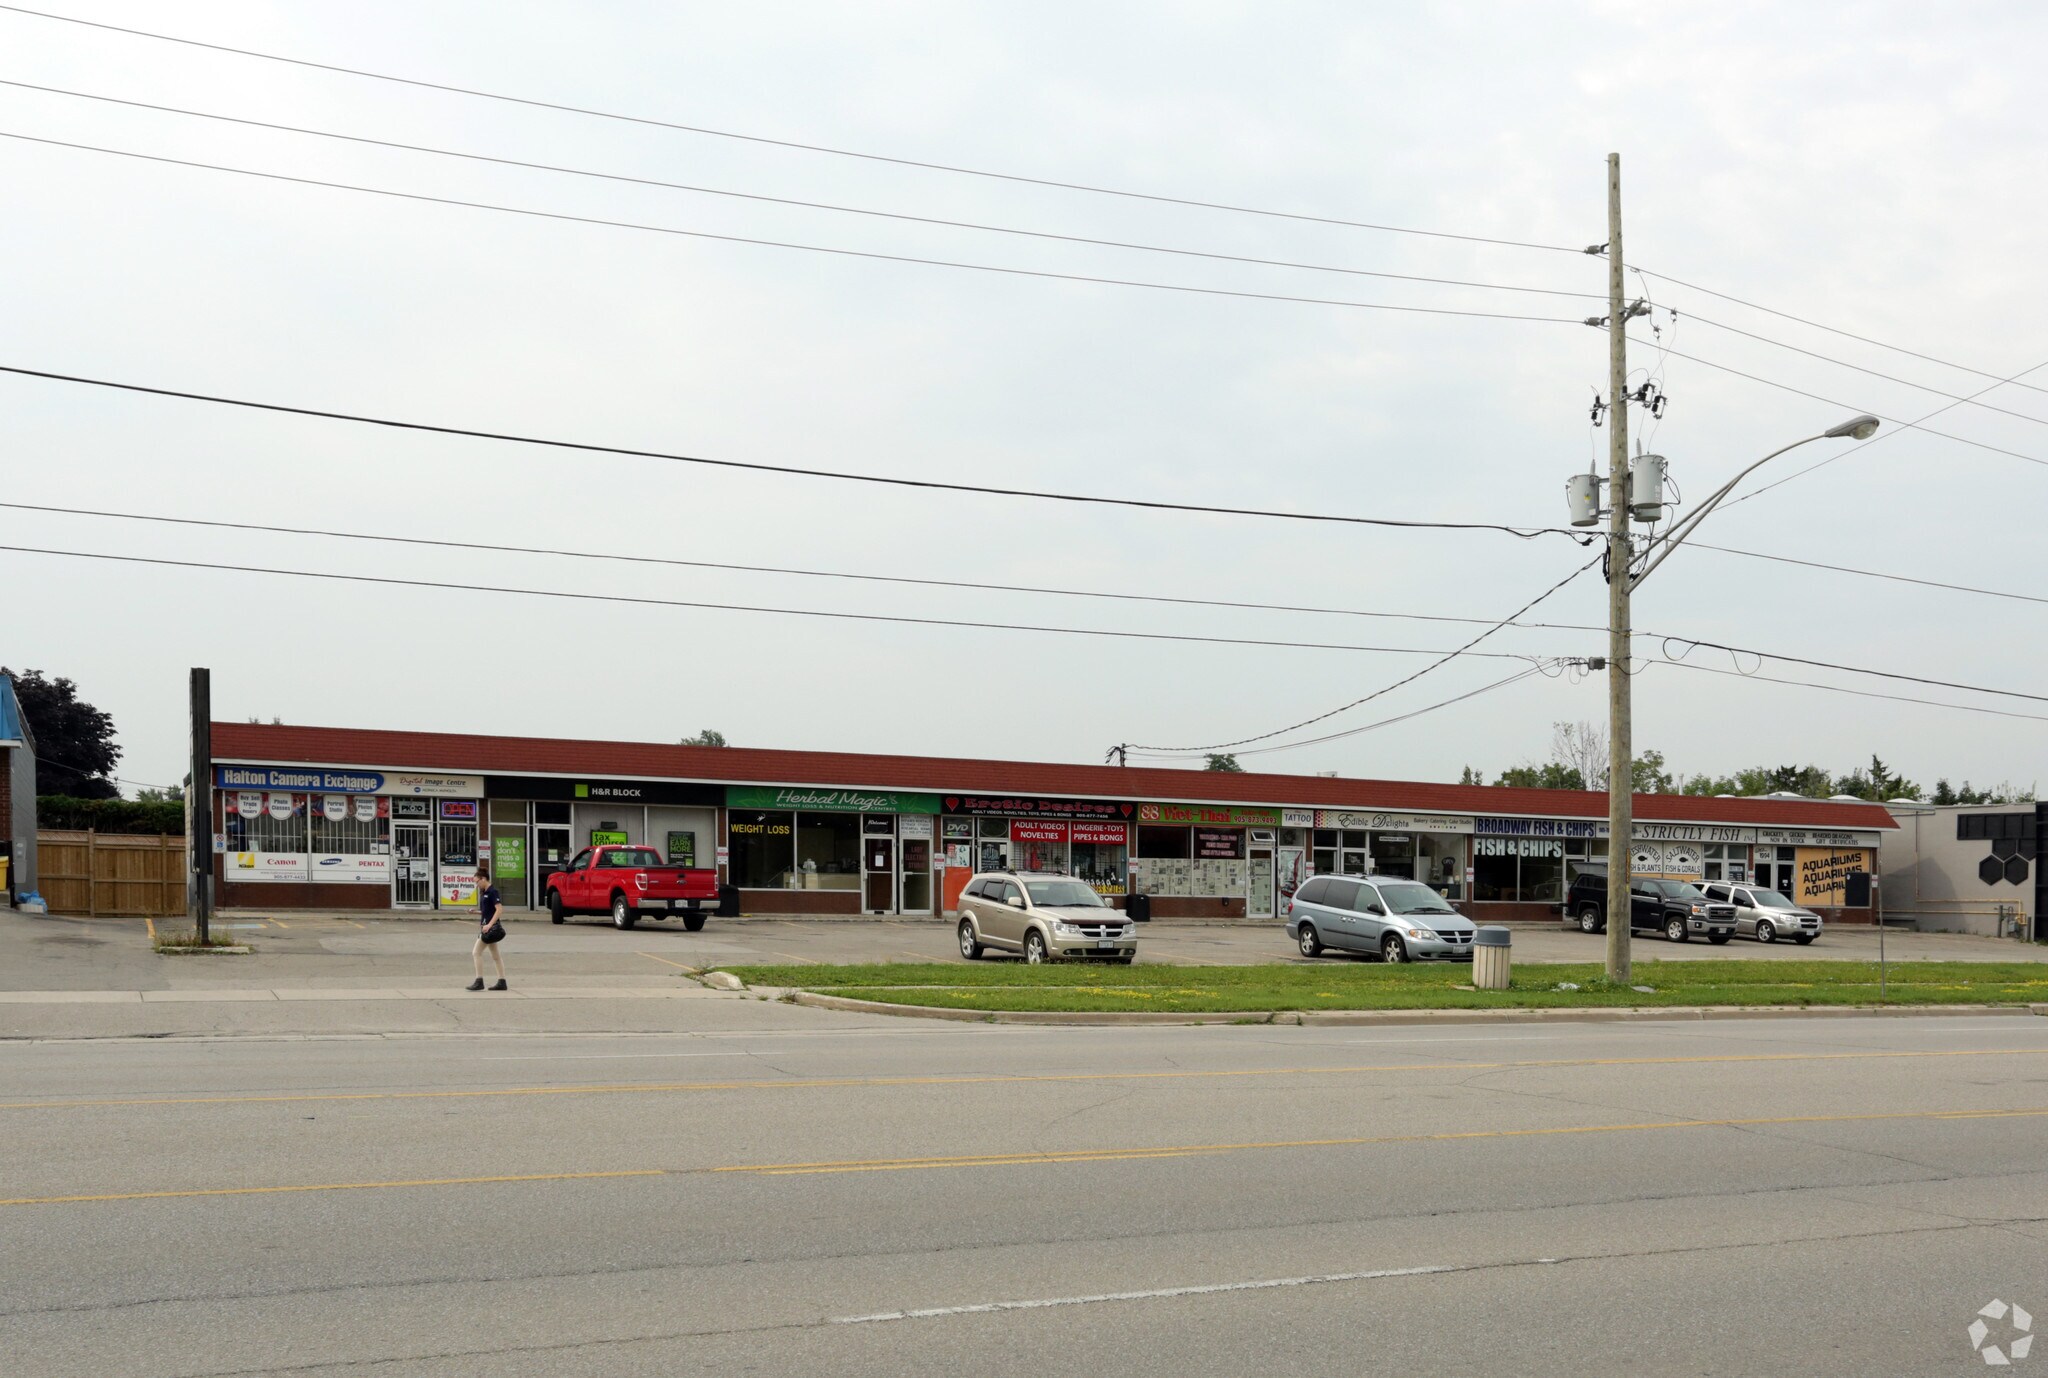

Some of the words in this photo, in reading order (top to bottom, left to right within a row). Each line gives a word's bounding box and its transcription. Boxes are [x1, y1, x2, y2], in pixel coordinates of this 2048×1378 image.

[225, 769, 266, 784] Halton
[270, 771, 320, 787] Camera
[324, 774, 378, 791] Exchange
[400, 776, 423, 786] Digital
[592, 788, 610, 796] H&R
[613, 789, 641, 797] BLOCK
[776, 790, 838, 804] Herbal
[839, 792, 888, 811] Magic
[964, 798, 1034, 811] Erotic
[1039, 801, 1117, 813] Desires
[1141, 805, 1159, 820] 88
[1164, 806, 1231, 823] Viet-Thai
[1284, 814, 1311, 823] TATTOO
[1338, 813, 1368, 828] Edible
[1371, 814, 1409, 829] Delights
[1477, 818, 1530, 835] BROADWAY
[1533, 820, 1555, 836] FISH
[1557, 822, 1565, 835] &
[1566, 822, 1594, 837] CHIPS
[731, 824, 764, 833] WEIGHT
[767, 825, 790, 835] LOSS
[947, 823, 969, 833] DVD
[1641, 825, 1705, 840] STRICTLY
[1710, 828, 1742, 841] FISH
[594, 833, 610, 841] tax
[1020, 832, 1059, 840] NOVELTIES
[1474, 838, 1505, 856] FISH
[1507, 840, 1518, 855] &
[1520, 840, 1562, 857] CHIPS
[1666, 845, 1700, 863] SALTWATER
[1642, 864, 1661, 872] PLANTS
[1802, 852, 1862, 872] AQUARIUMS
[1682, 865, 1700, 873] CORALS
[451, 890, 459, 902] 3
